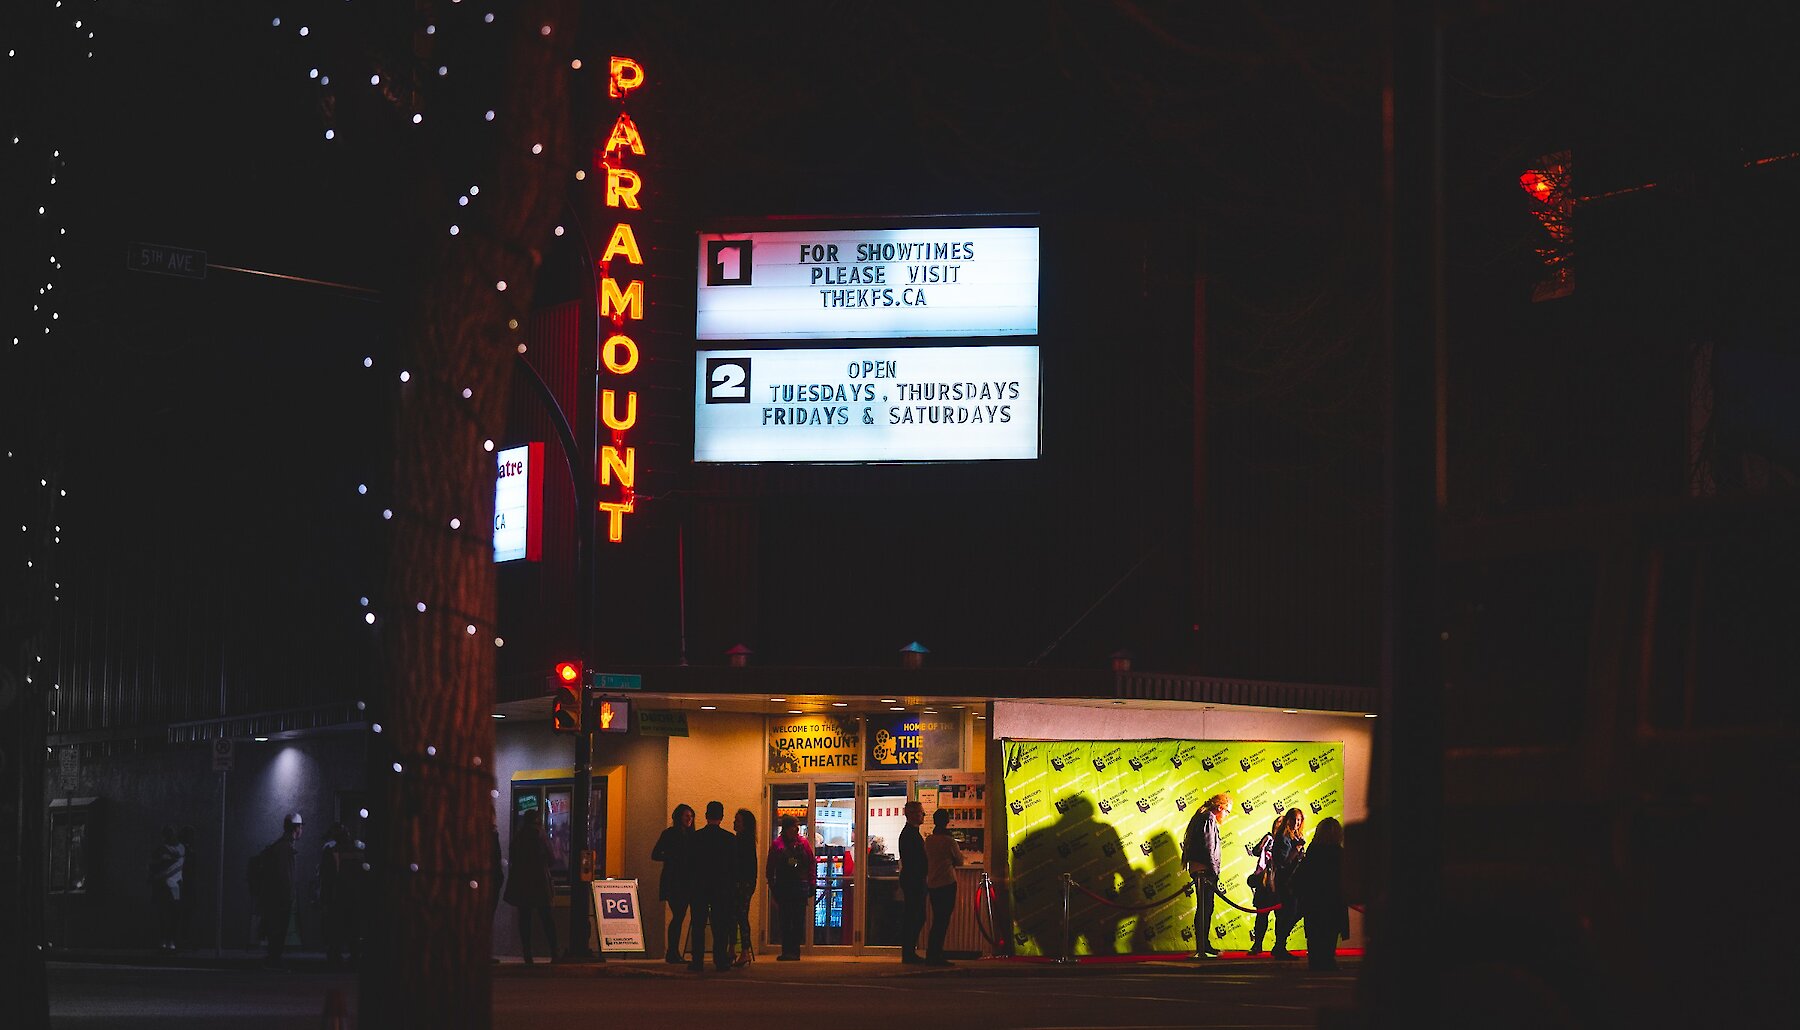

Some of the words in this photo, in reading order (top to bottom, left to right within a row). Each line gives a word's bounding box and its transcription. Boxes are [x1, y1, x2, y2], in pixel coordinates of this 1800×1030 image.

[141, 249, 163, 266] 5TH
[168, 253, 193, 272] AVE
[800, 244, 839, 262] FOR
[856, 241, 975, 262] SHOWTIMES
[717, 246, 741, 280] 1
[811, 265, 886, 284] PLEASE
[909, 265, 961, 283] VISIT
[601, 56, 646, 542] PARAMOUNT
[820, 288, 928, 308] THEKFS.CA
[848, 360, 897, 379] OPEN
[711, 363, 746, 398] 2
[896, 382, 1020, 401] THURSDAYS
[762, 407, 849, 426] FRIDAYS
[862, 408, 875, 425] &
[889, 406, 1011, 425] SATURDAYS
[499, 460, 523, 479] atre
[773, 725, 808, 733] WELCOME
[810, 724, 820, 732] TO
[821, 724, 836, 732] THE
[903, 723, 926, 731] HOME
[927, 723, 938, 731] OF
[779, 736, 859, 750] PARAMOUNT
[899, 736, 923, 749] THE
[802, 754, 858, 767] THEATRE
[899, 752, 923, 765] KFS
[606, 898, 629, 914] PG
